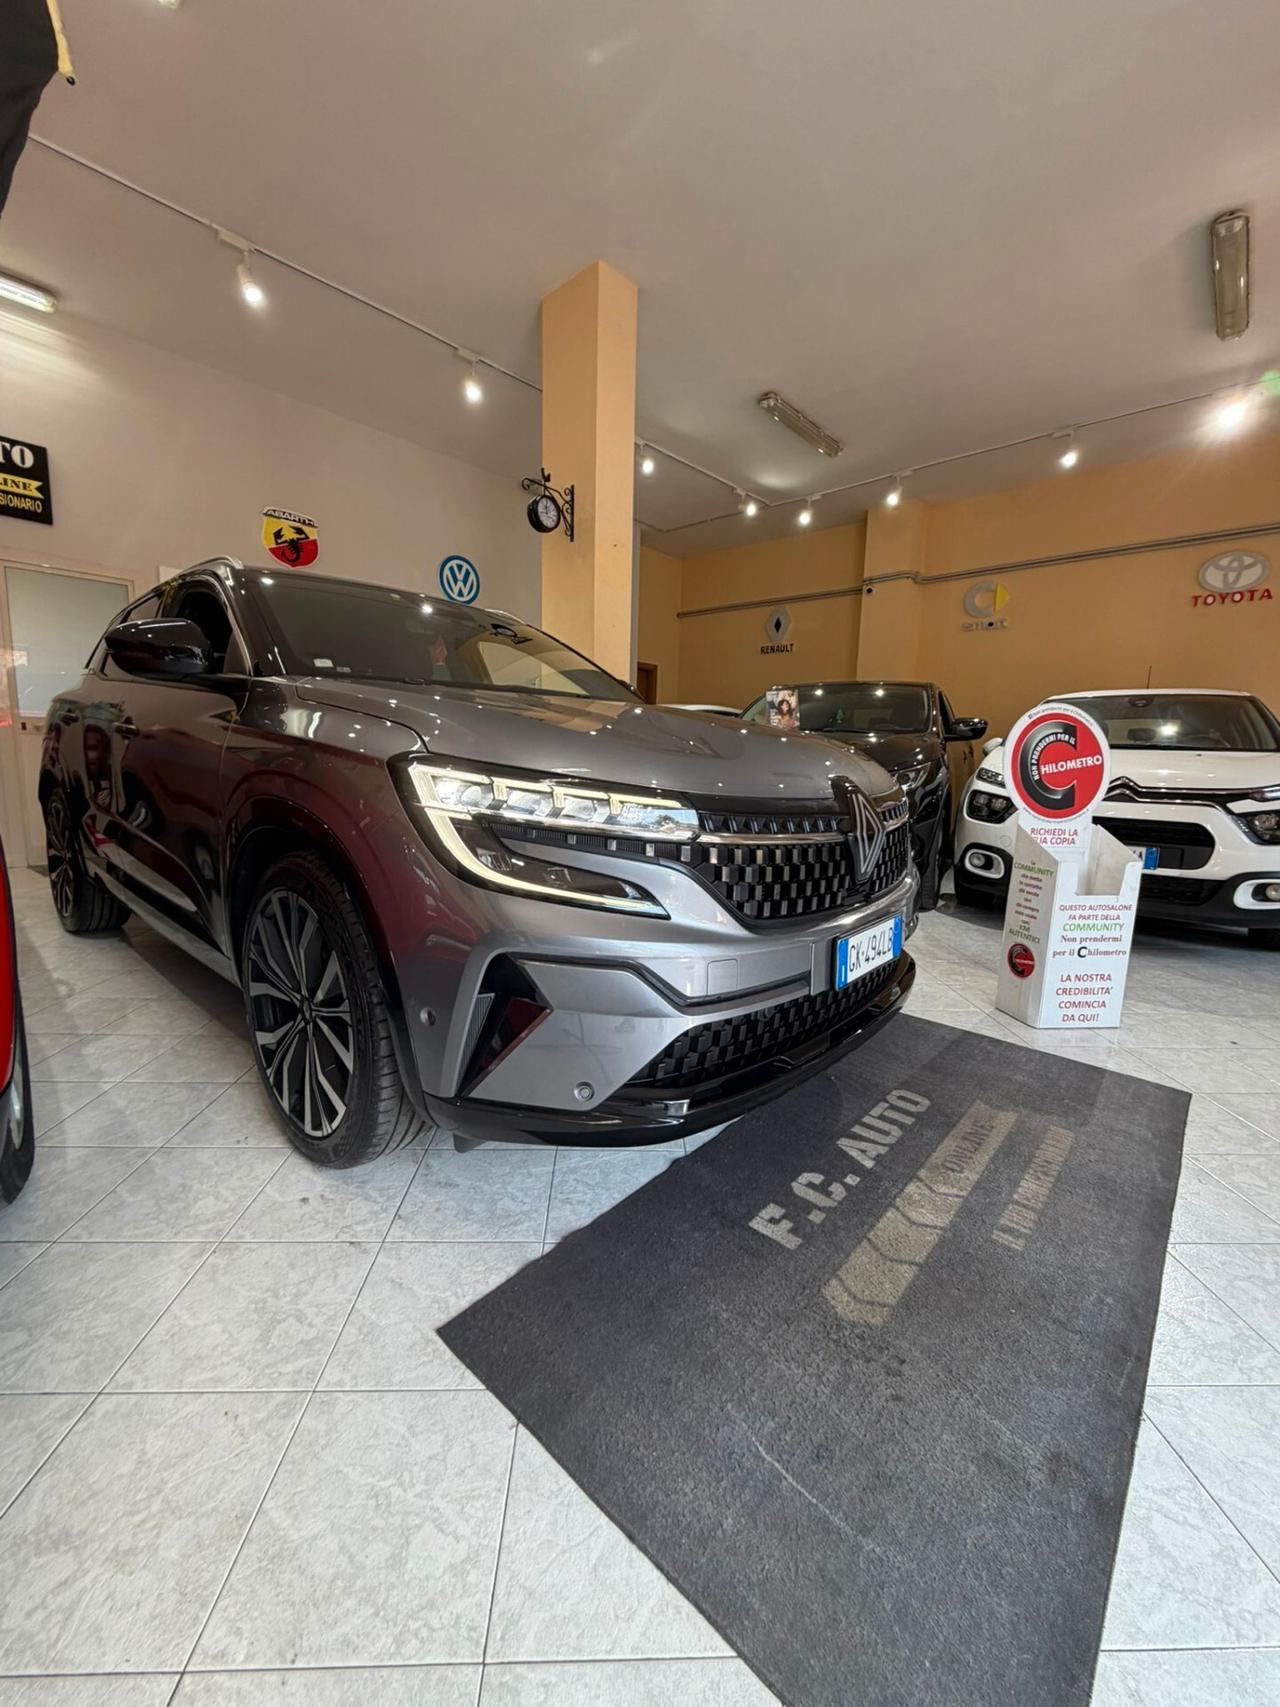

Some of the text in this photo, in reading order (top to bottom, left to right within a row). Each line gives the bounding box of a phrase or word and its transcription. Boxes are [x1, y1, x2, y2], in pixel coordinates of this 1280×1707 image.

[267, 509, 318, 527] ABARTH
[1191, 588, 1273, 607] TOYOTA
[760, 643, 794, 655] RENAULT
[1057, 733, 1070, 742] PER
[1030, 827, 1078, 836] RICHIEDI LA
[1050, 837, 1076, 845] COPIA
[1014, 862, 1055, 876] COMMUNITY
[1059, 904, 1087, 912] QUESTO
[1063, 922, 1125, 931] COMMUNITY
[1060, 935, 1122, 944] Non prendermi
[1052, 950, 1067, 958] per
[1068, 948, 1075, 956] il
[1060, 973, 1112, 982] LA NOSTRA
[1058, 1000, 1107, 1009] COMINCIA
[1062, 1013, 1100, 1023] DA QUI!
